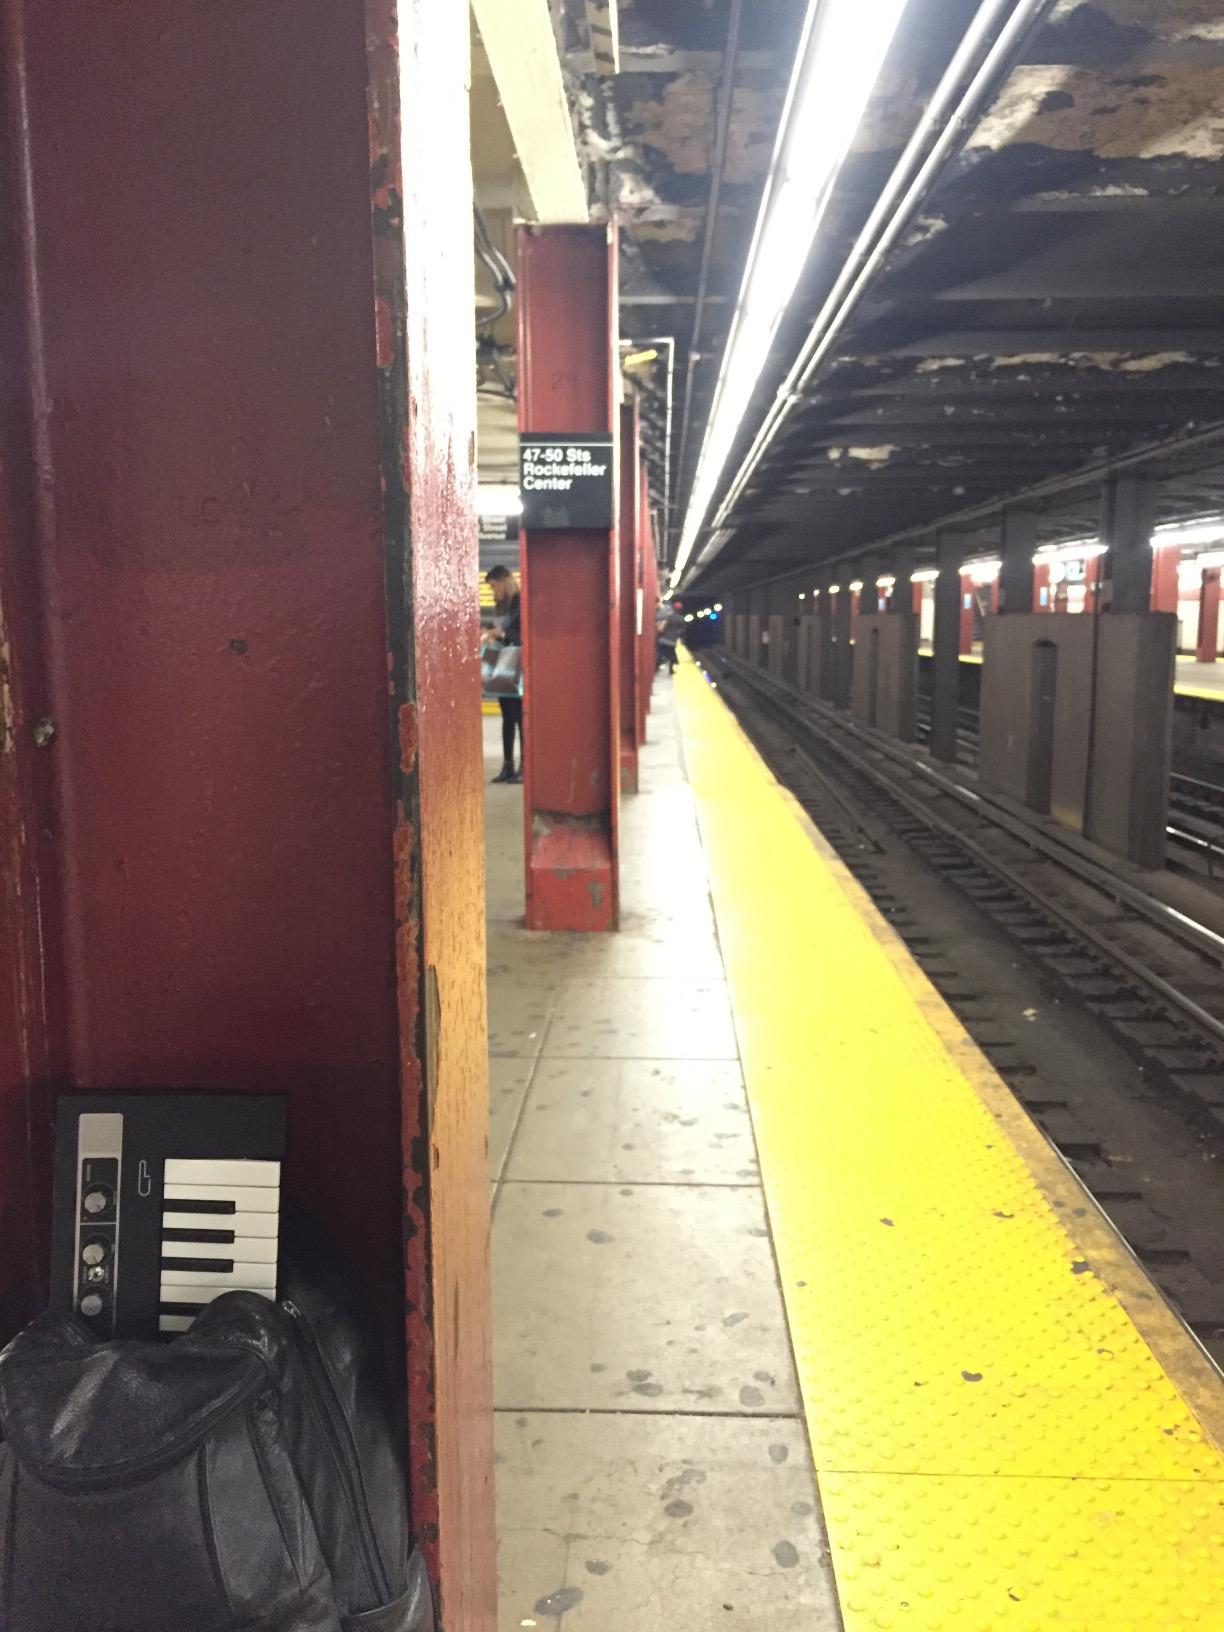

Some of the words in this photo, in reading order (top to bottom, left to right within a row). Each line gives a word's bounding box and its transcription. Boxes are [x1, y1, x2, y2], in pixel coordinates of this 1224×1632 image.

[523, 448, 563, 462] 47-50
[566, 448, 591, 462] Sts
[523, 462, 607, 476] Rockefeller
[523, 476, 573, 490] Center
